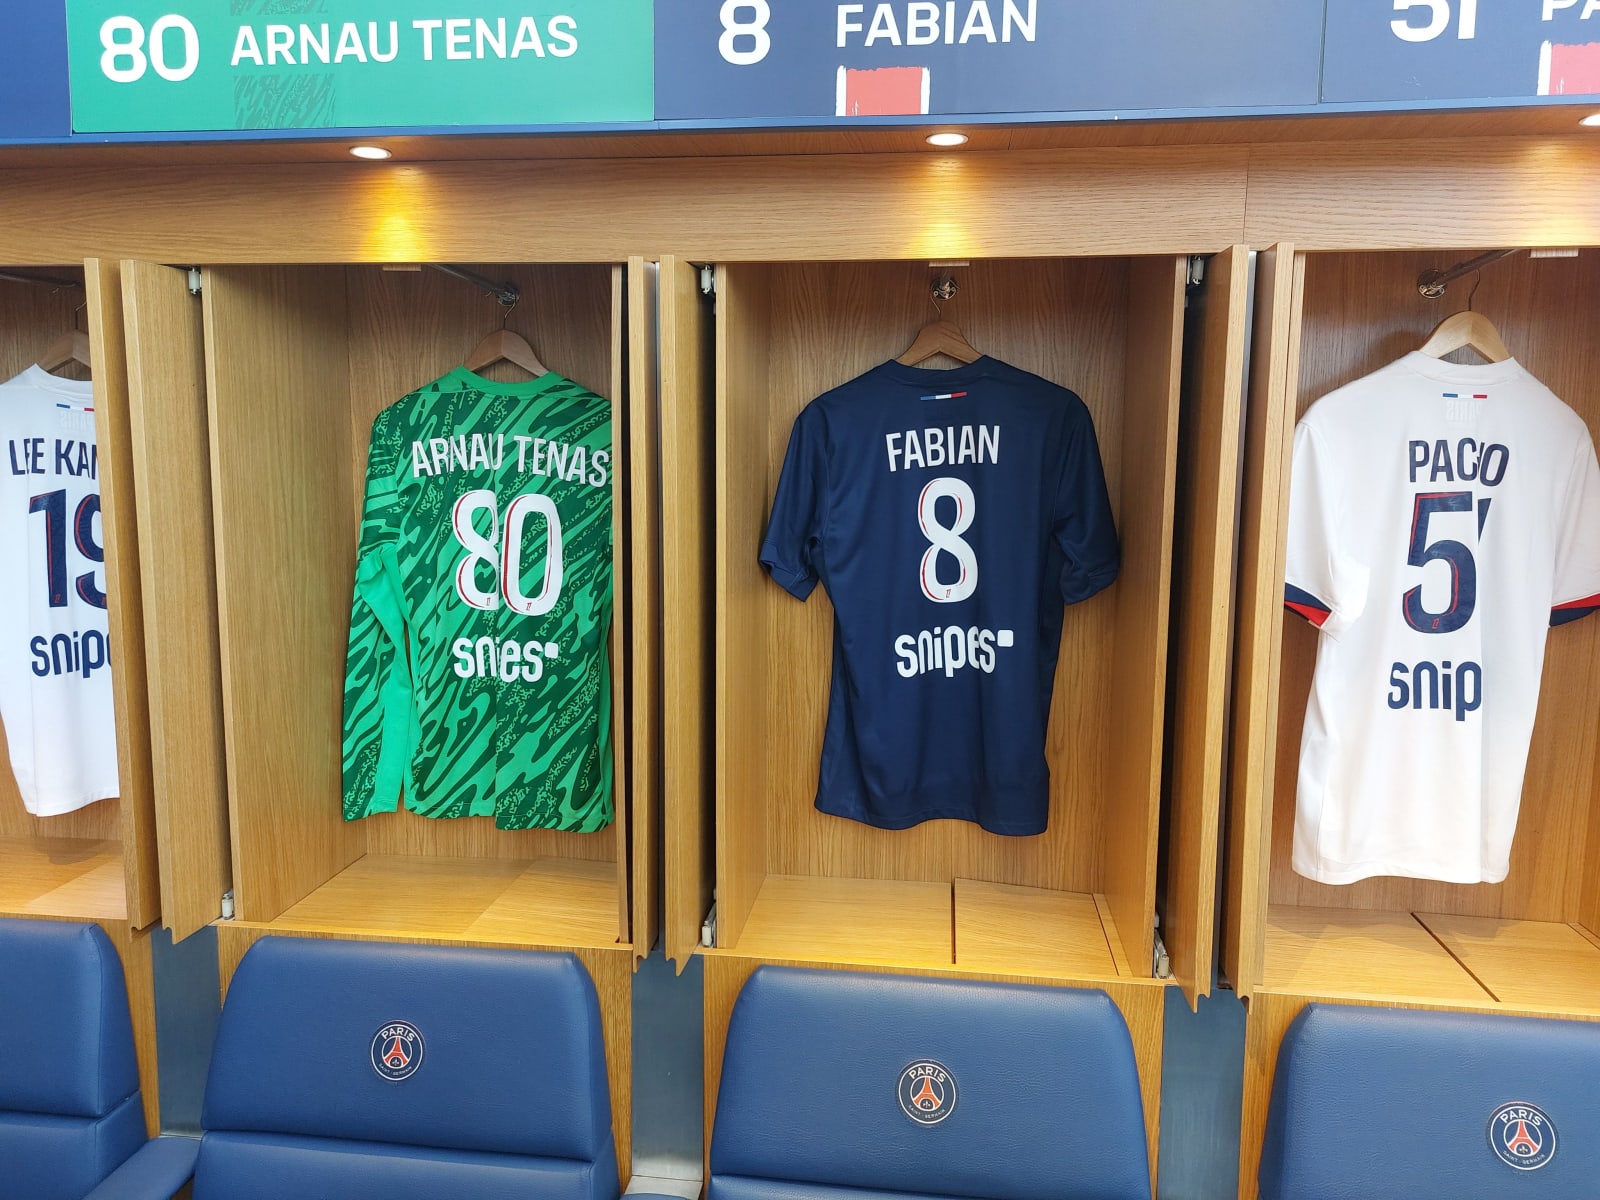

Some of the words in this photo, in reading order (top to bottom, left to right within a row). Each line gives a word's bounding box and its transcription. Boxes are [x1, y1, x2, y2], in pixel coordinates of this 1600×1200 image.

[99, 13, 200, 83] 80
[230, 21, 399, 66] ARNAU
[412, 14, 578, 61] TENAS
[718, 0, 771, 65] 8
[836, 0, 1037, 48] FABIAN
[412, 433, 504, 478] ARNAU
[513, 435, 609, 488] TENAS
[885, 425, 1000, 472] FABIAN
[451, 489, 564, 616] 80
[917, 477, 978, 603] 8
[894, 625, 996, 678] snipes
[381, 1027, 415, 1042] PARIS
[908, 1066, 946, 1083] PARIS
[1500, 1109, 1543, 1126] PARIS
